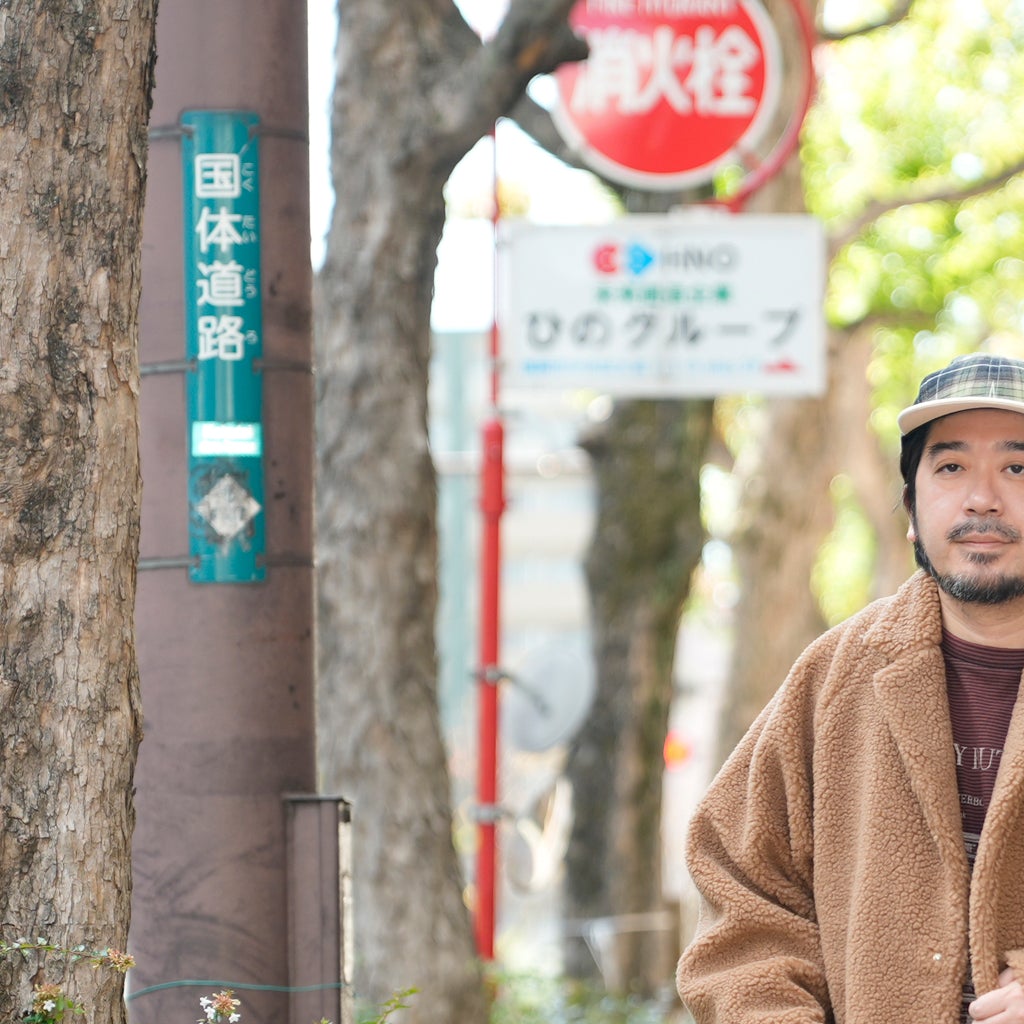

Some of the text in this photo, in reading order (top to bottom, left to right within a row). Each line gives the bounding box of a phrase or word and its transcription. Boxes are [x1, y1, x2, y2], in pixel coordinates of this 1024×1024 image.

[571, 25, 761, 116] 消火栓
[195, 153, 246, 361] 国体道路
